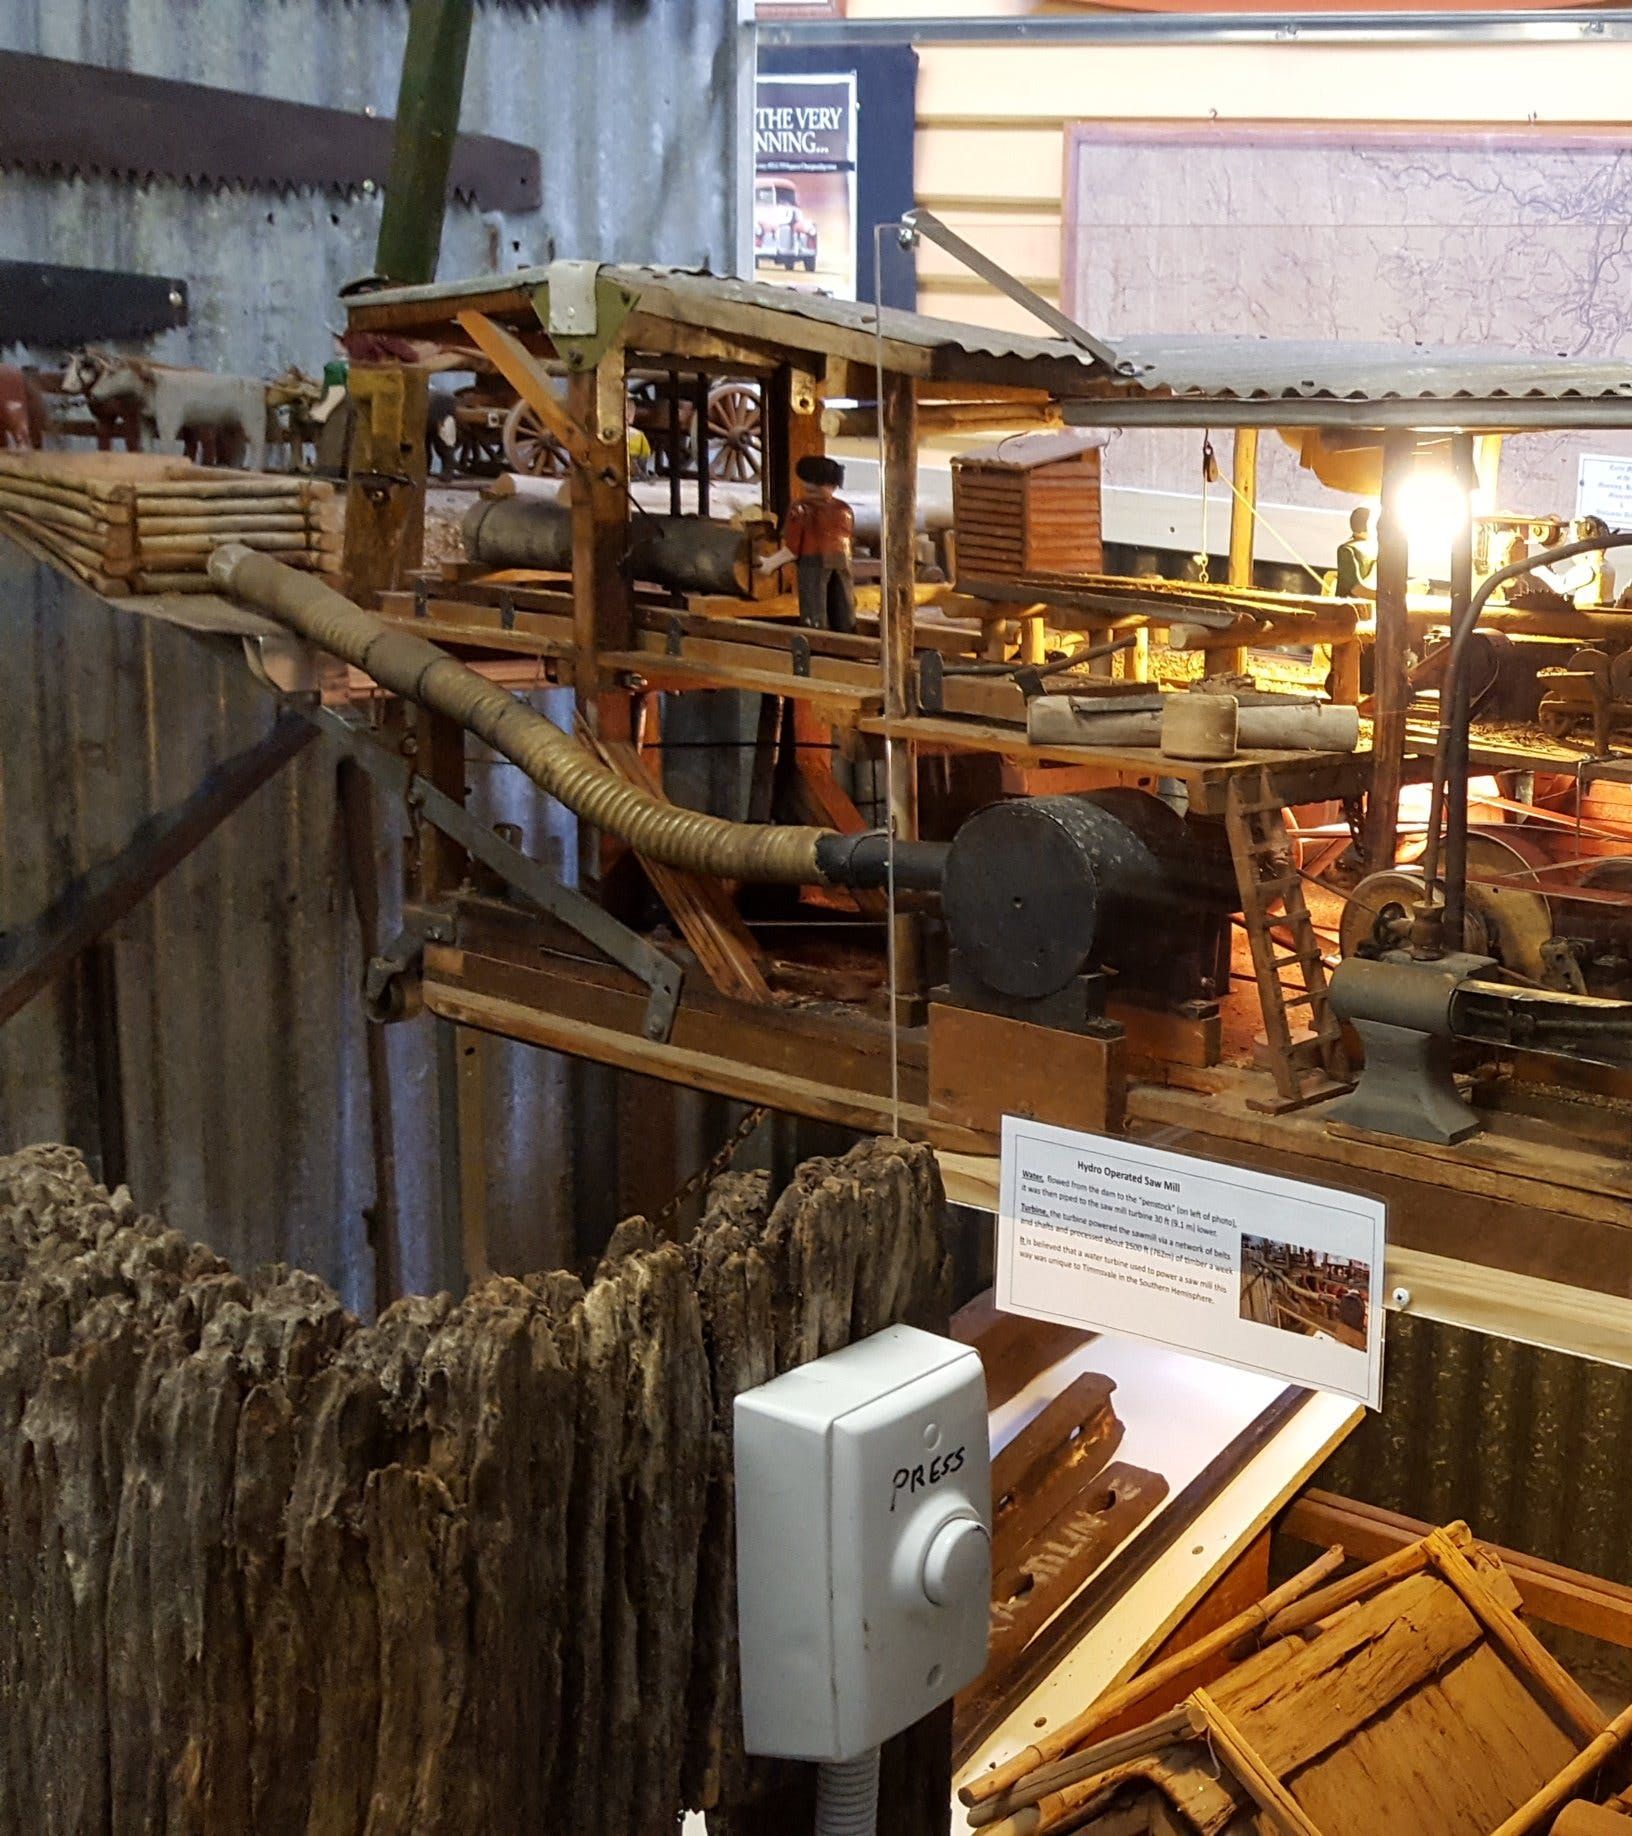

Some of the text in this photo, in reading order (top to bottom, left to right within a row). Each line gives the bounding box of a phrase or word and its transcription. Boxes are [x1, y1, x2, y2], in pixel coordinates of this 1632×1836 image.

[757, 107, 843, 130] THE VERY
[1077, 1160, 1179, 1192] Hydro Operated Saw Mill
[889, 1446, 965, 1512] PRESS
